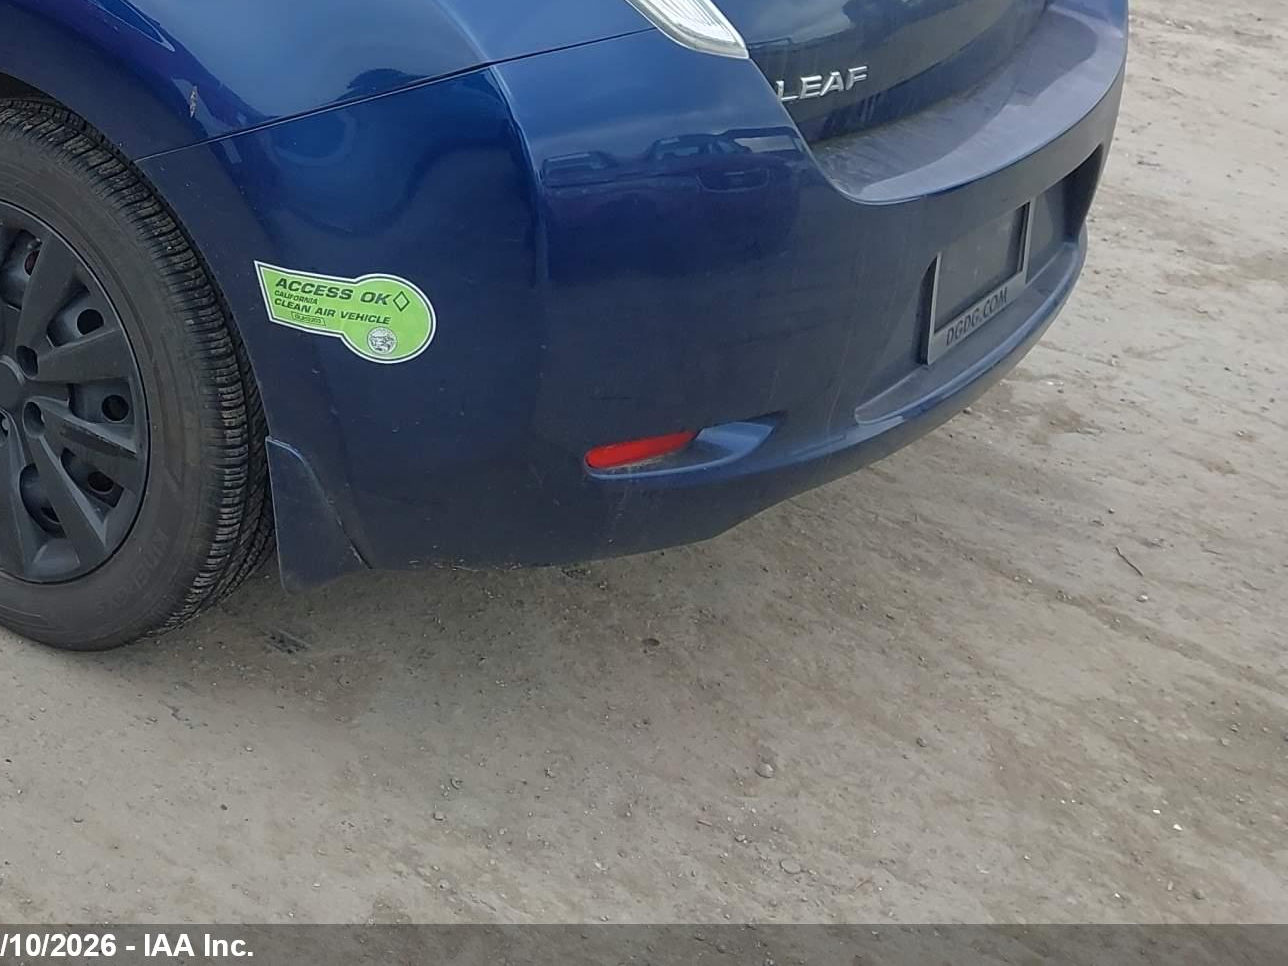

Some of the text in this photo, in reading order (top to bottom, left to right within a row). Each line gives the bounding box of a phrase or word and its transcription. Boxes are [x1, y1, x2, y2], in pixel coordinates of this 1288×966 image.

[775, 65, 868, 102] LEAF
[274, 289, 319, 305] CALIFORNIA
[275, 278, 392, 306] ACCESS OK
[274, 298, 392, 325] CLEAN AIR VEHICLE
[945, 286, 1009, 347] DGDG.COM
